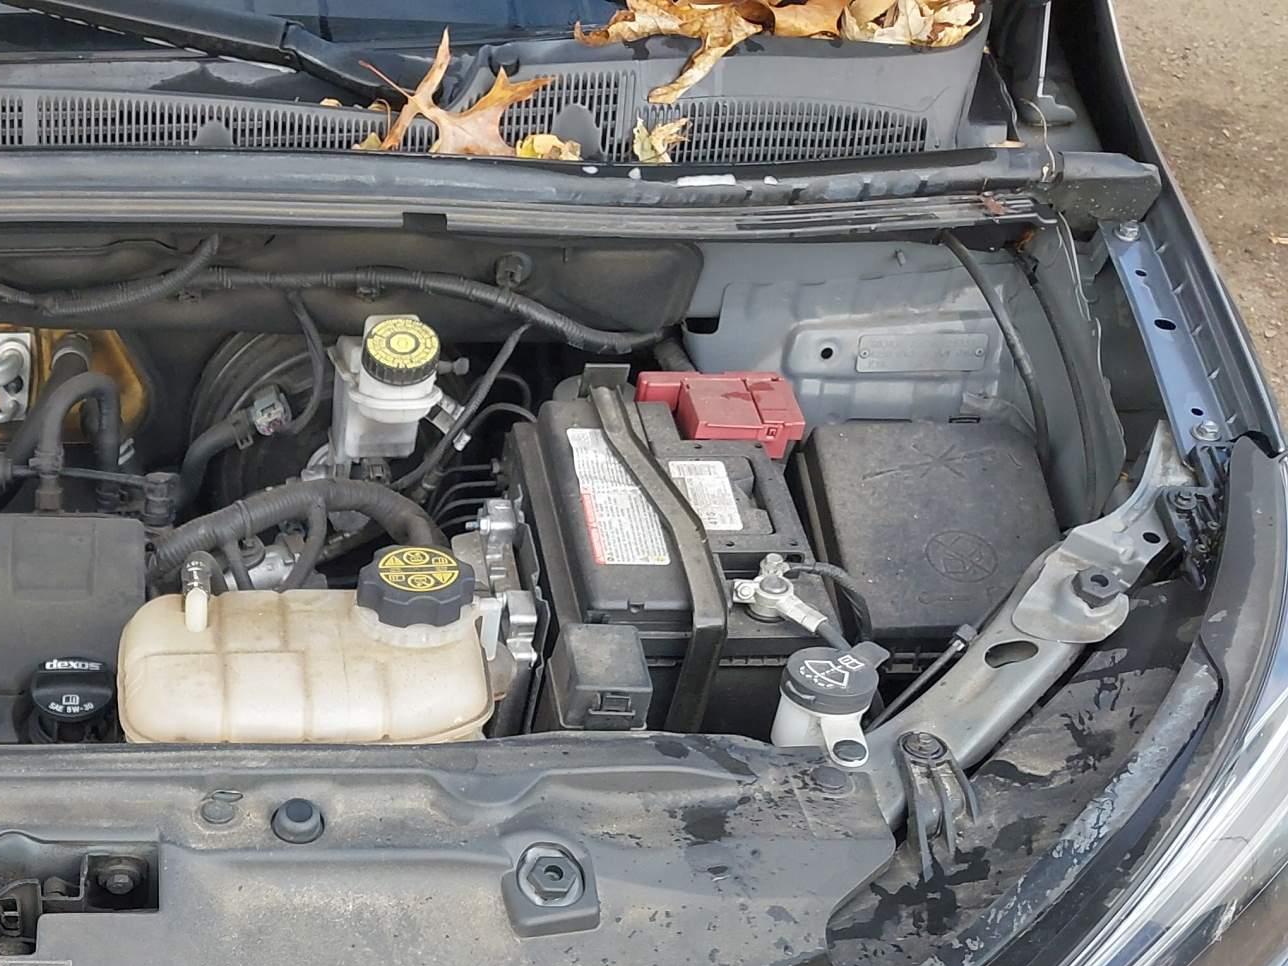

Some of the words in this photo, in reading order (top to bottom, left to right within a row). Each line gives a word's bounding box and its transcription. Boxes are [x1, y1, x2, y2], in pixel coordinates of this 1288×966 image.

[45, 658, 102, 671] dexos
[48, 702, 64, 713] SAE
[66, 702, 94, 713] 5W-30
